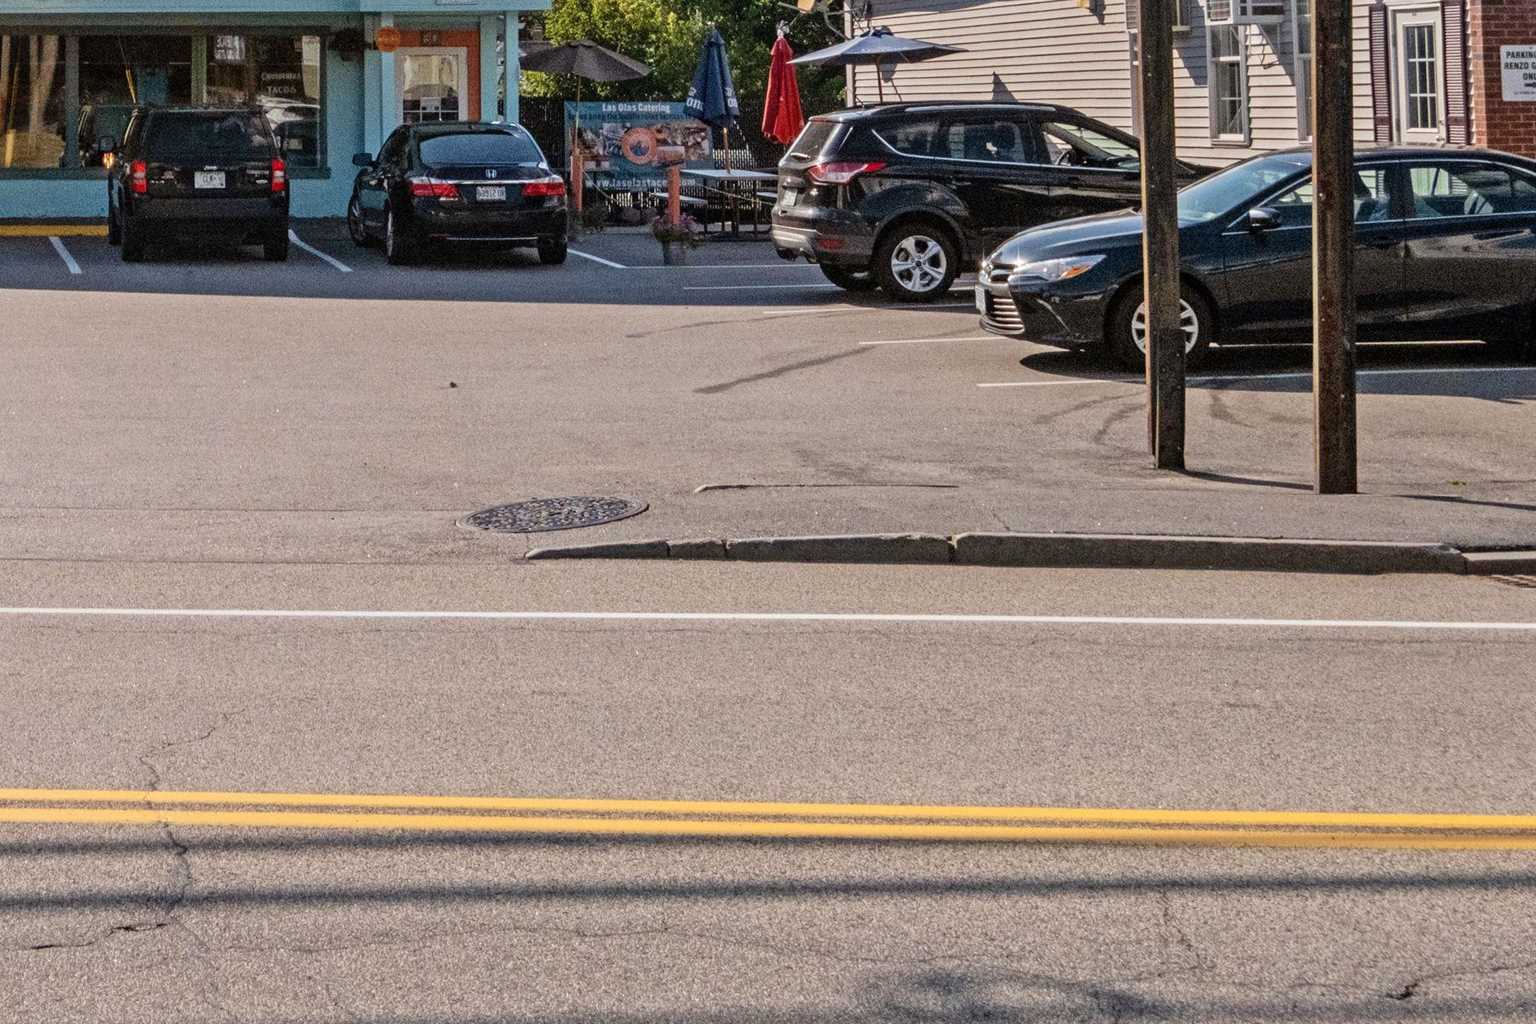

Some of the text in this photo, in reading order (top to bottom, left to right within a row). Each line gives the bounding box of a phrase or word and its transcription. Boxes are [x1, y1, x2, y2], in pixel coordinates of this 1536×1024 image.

[267, 86, 297, 94] TACOS
[602, 103, 671, 114] Las Olas Catering
